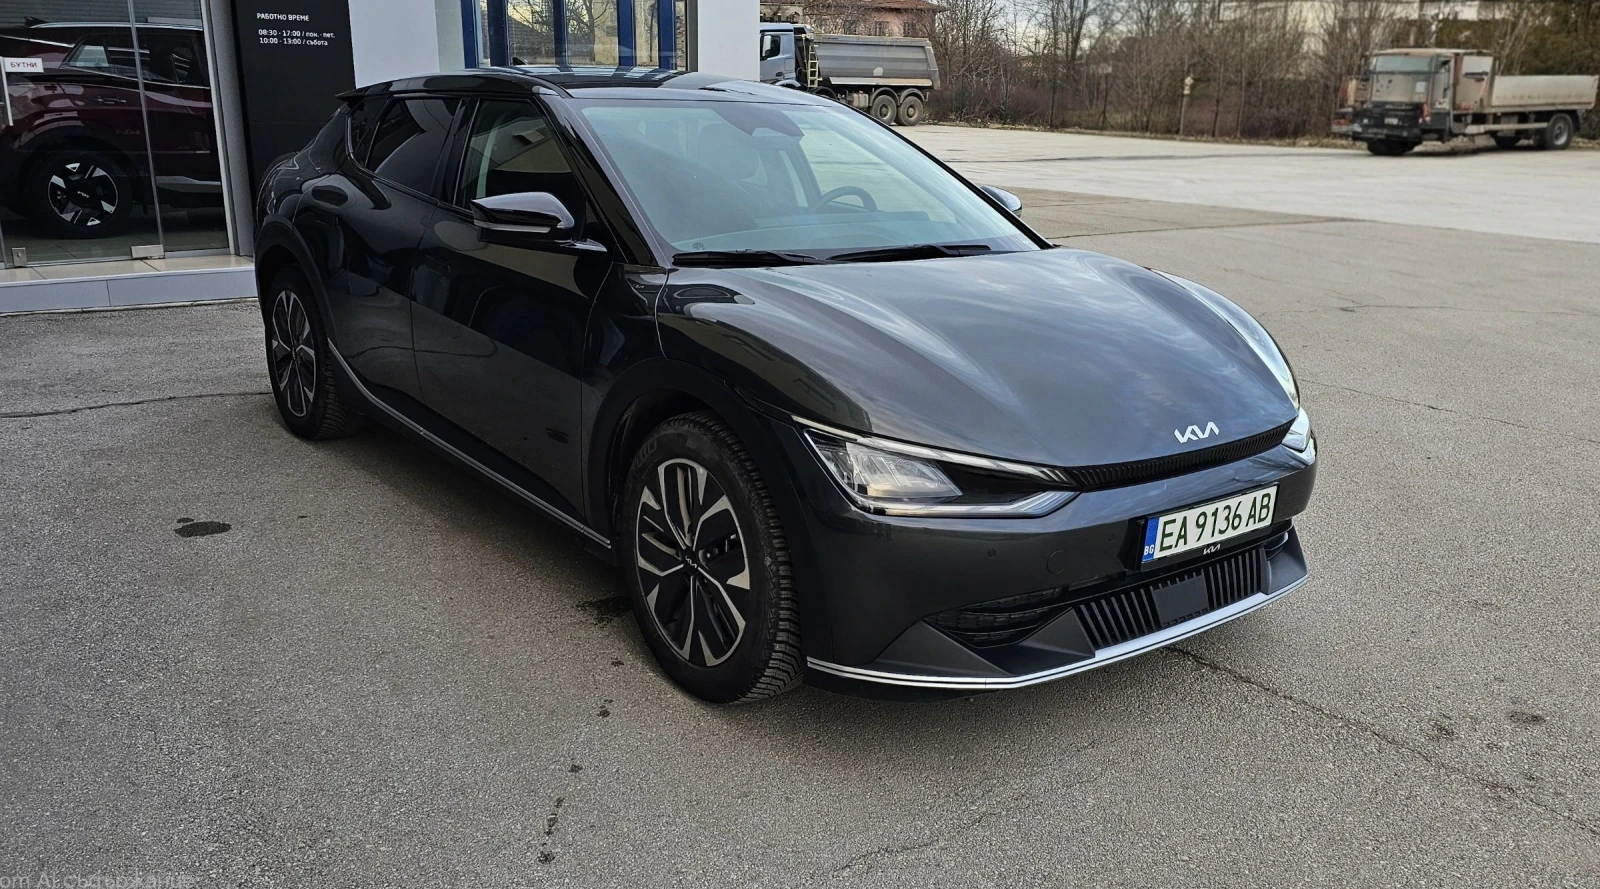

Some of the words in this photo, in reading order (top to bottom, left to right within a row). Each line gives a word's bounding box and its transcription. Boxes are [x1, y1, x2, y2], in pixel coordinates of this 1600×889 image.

[256, 12, 287, 20] РАБОТНО
[1173, 421, 1220, 444] KIA
[1158, 514, 1188, 553] EA
[1195, 500, 1243, 543] 9136
[1245, 492, 1272, 527] AB
[1143, 544, 1155, 556] BG
